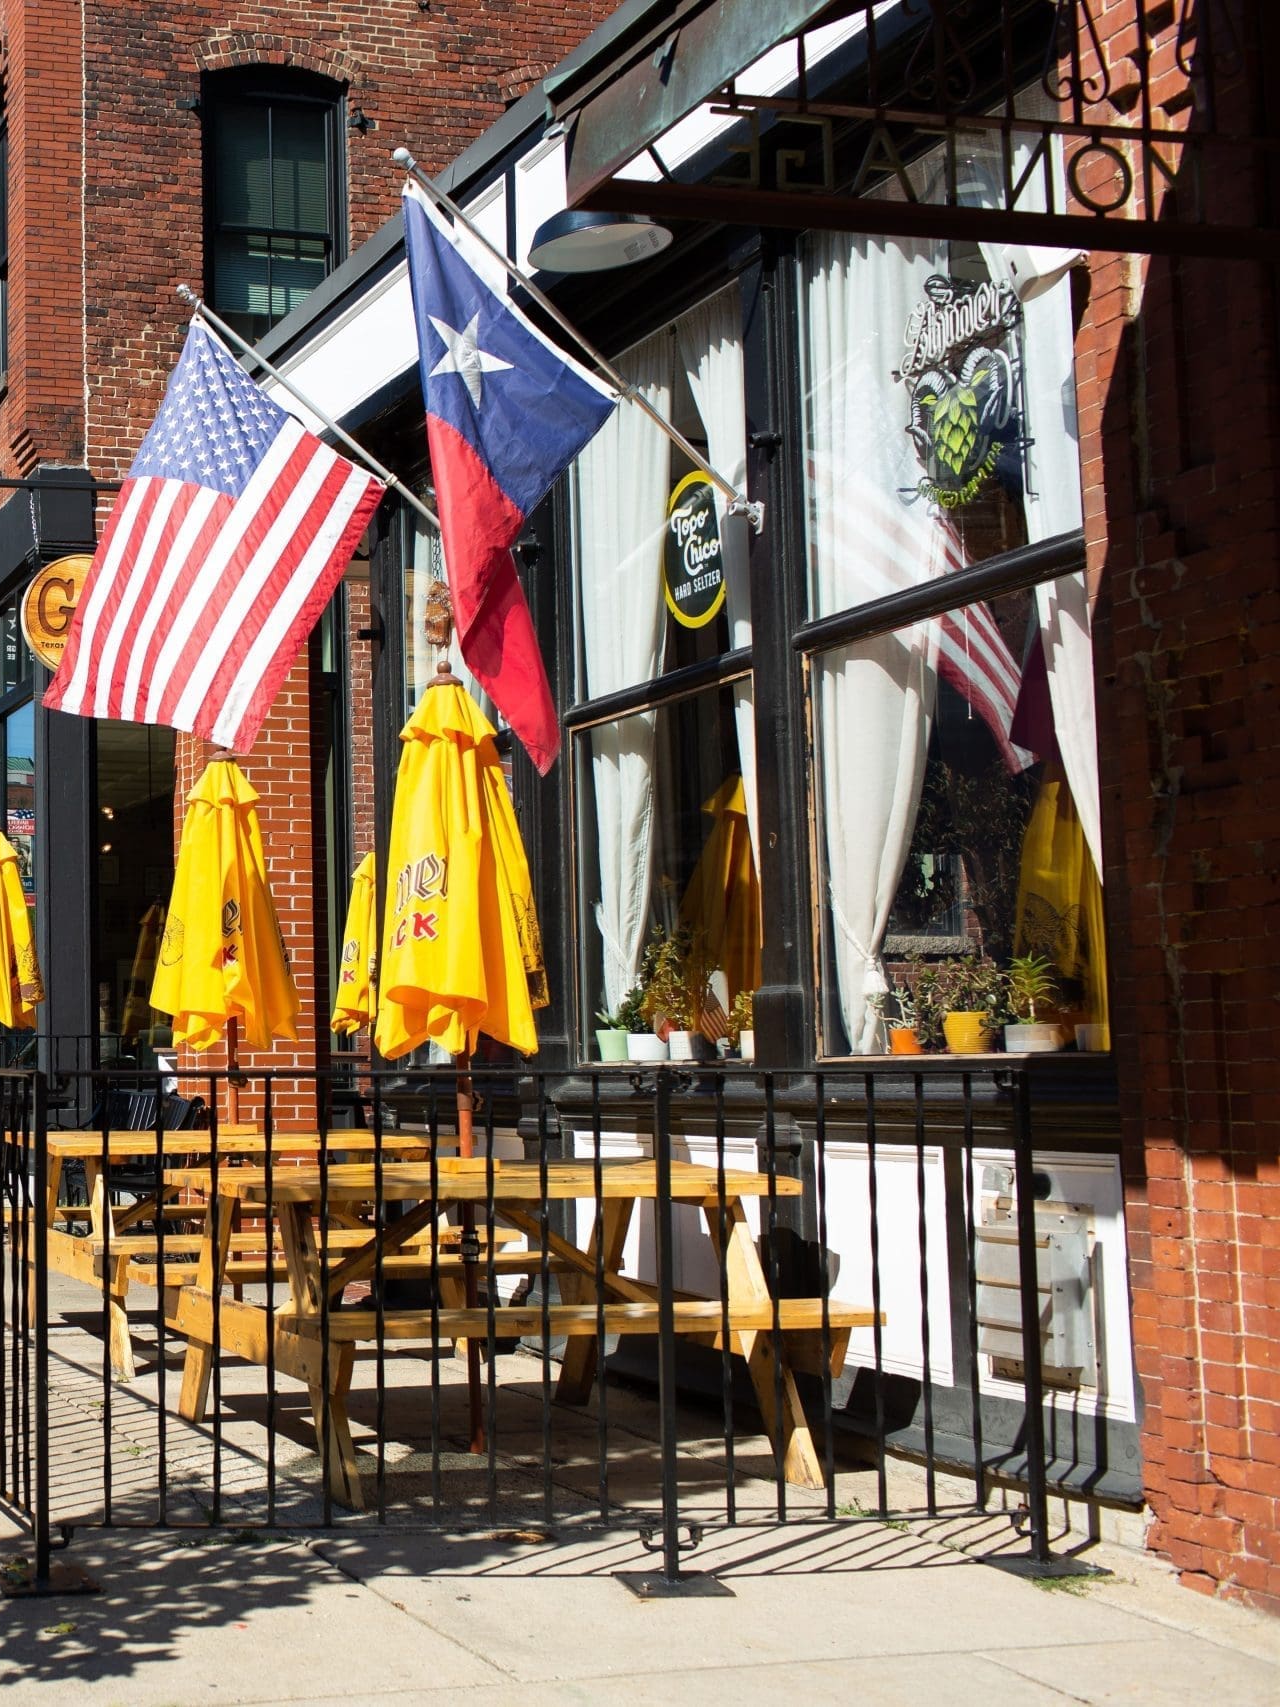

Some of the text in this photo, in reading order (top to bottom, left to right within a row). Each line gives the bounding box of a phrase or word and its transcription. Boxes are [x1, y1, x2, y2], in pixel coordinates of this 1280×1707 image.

[671, 505, 709, 547] Topo
[683, 533, 722, 577] Chico
[674, 569, 721, 601] HARD SELTZER
[41, 642, 65, 650] Texas
